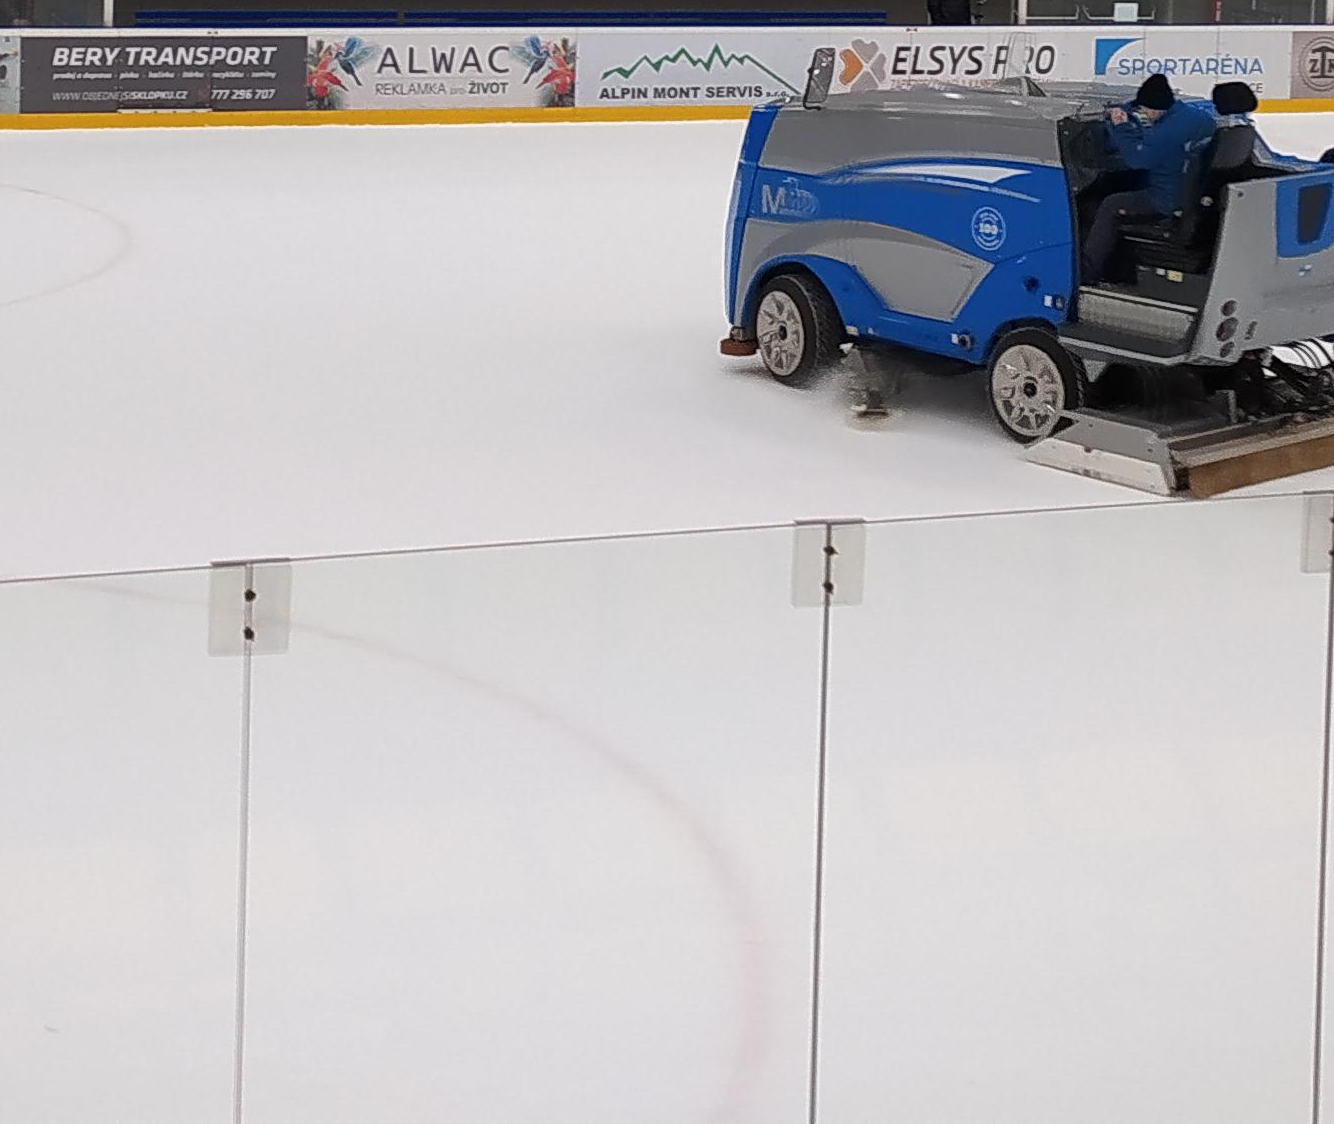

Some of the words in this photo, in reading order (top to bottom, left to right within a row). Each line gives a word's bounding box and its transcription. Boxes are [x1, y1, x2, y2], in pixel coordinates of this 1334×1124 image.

[52, 46, 121, 66] BERY
[125, 46, 277, 66] TRANSPORT
[376, 45, 511, 74] ALWAC
[891, 45, 985, 75] ELSYS
[1118, 57, 1264, 75] SPORTARÉNA
[211, 89, 230, 100] 777
[255, 89, 276, 100] 707
[375, 83, 447, 96] REKLAMKA
[468, 81, 509, 94] ŽIVOT
[599, 87, 650, 100] ALPIN
[653, 86, 701, 99] MONT
[705, 85, 763, 98] SERVIS
